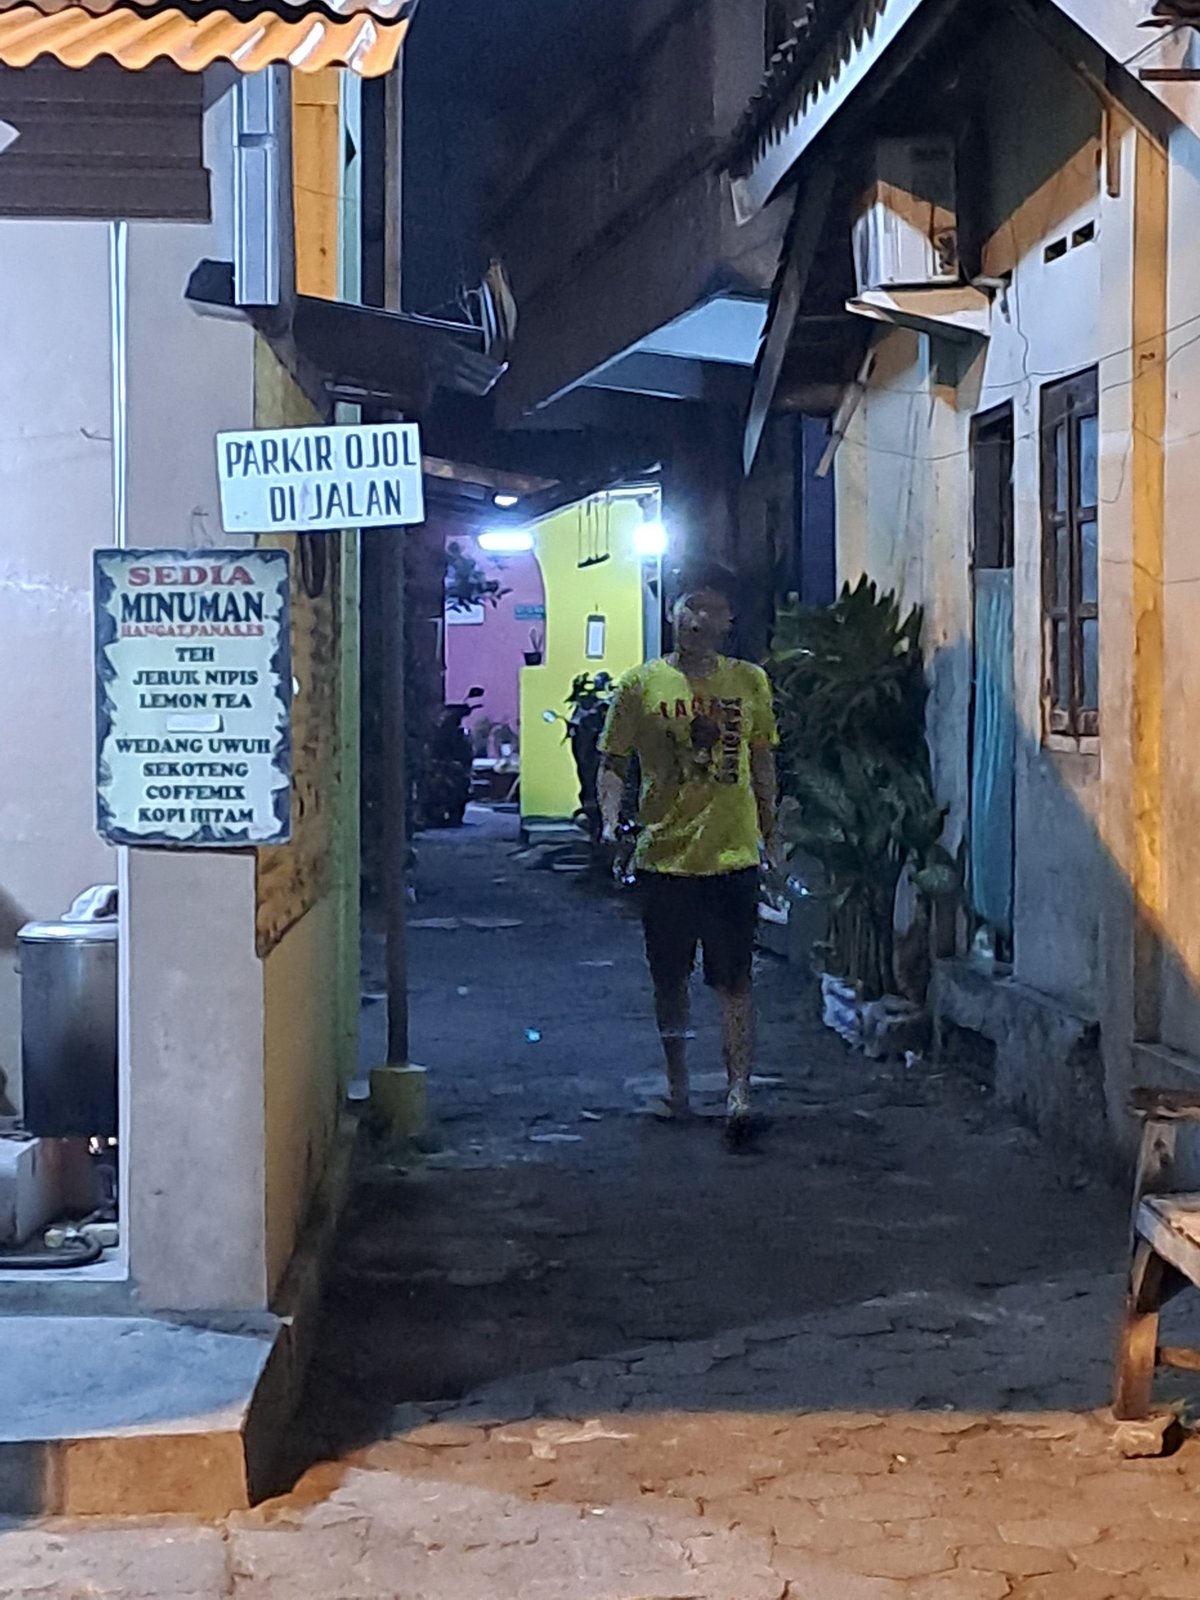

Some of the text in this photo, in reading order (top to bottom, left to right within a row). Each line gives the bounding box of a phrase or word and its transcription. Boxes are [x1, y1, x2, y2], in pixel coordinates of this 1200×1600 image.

[225, 431, 417, 478] PARKIR OJOL
[269, 479, 401, 522] DI JALAN
[128, 565, 255, 587] SEDIA
[120, 591, 264, 623] MINUMAN
[175, 647, 215, 662] TEH
[132, 670, 258, 685] JERUK NIPIS
[139, 693, 252, 708] LEMON TEA
[115, 738, 271, 753] WEDANG UWUH
[143, 762, 249, 777] SEKOTENG
[146, 785, 246, 800] COFFEMIX
[138, 808, 254, 823] KOPI HITAM
